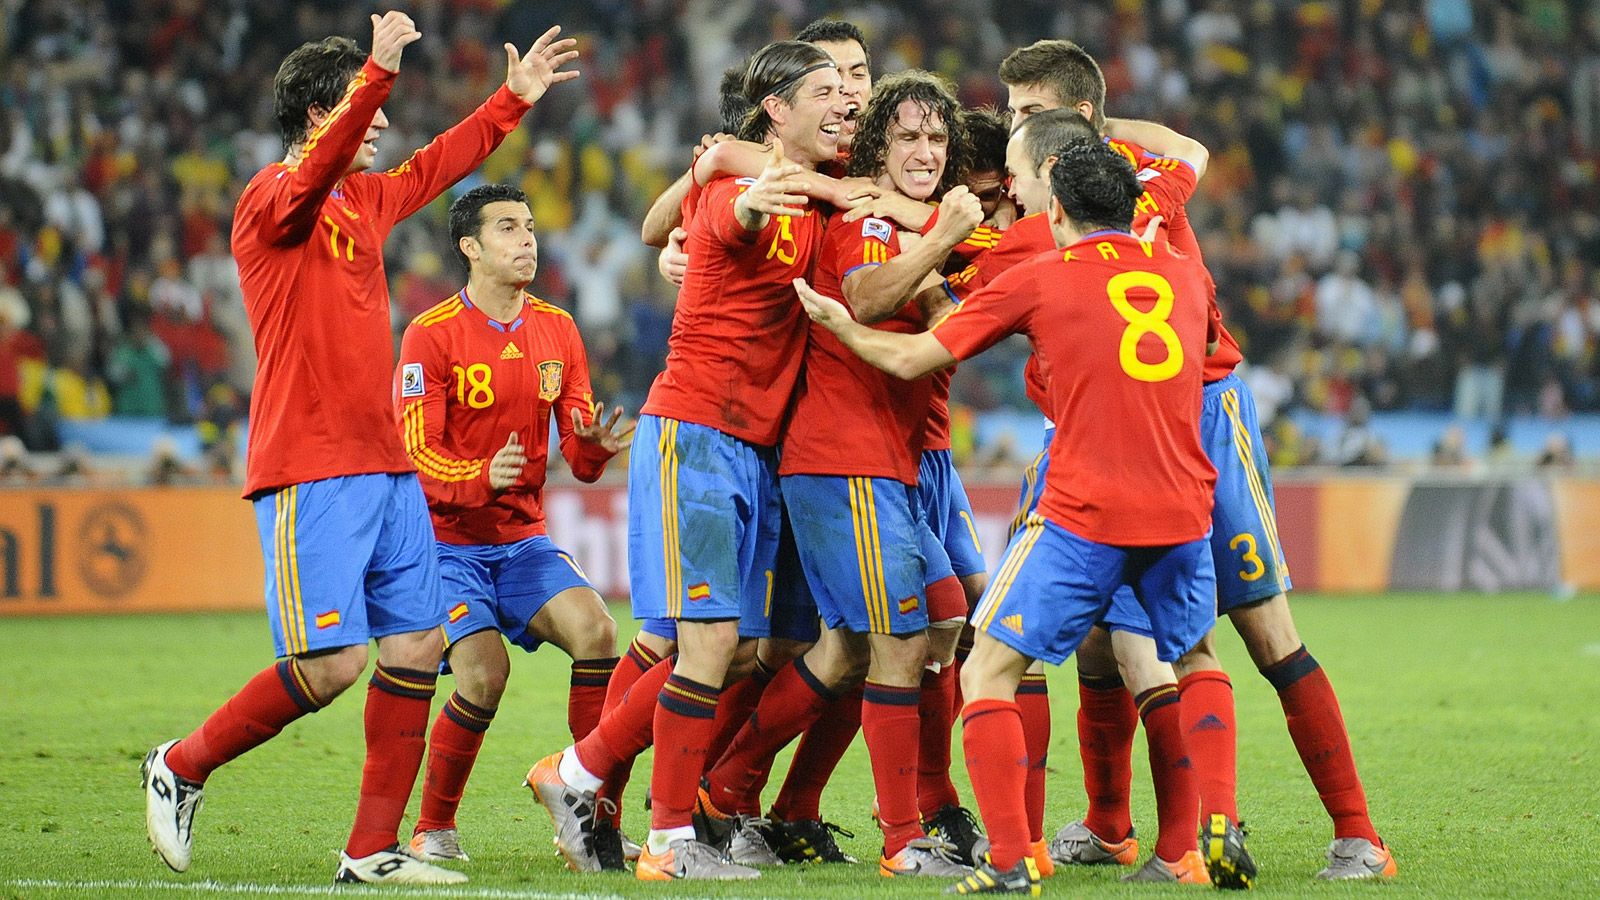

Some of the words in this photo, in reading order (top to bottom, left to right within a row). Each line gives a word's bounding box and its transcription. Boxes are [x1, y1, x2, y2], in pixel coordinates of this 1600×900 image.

[324, 214, 355, 262] 11
[766, 214, 798, 266] 15
[1106, 271, 1185, 382] 8
[500, 351, 524, 361] adidas
[453, 362, 496, 409] 18
[1229, 532, 1267, 582] 3
